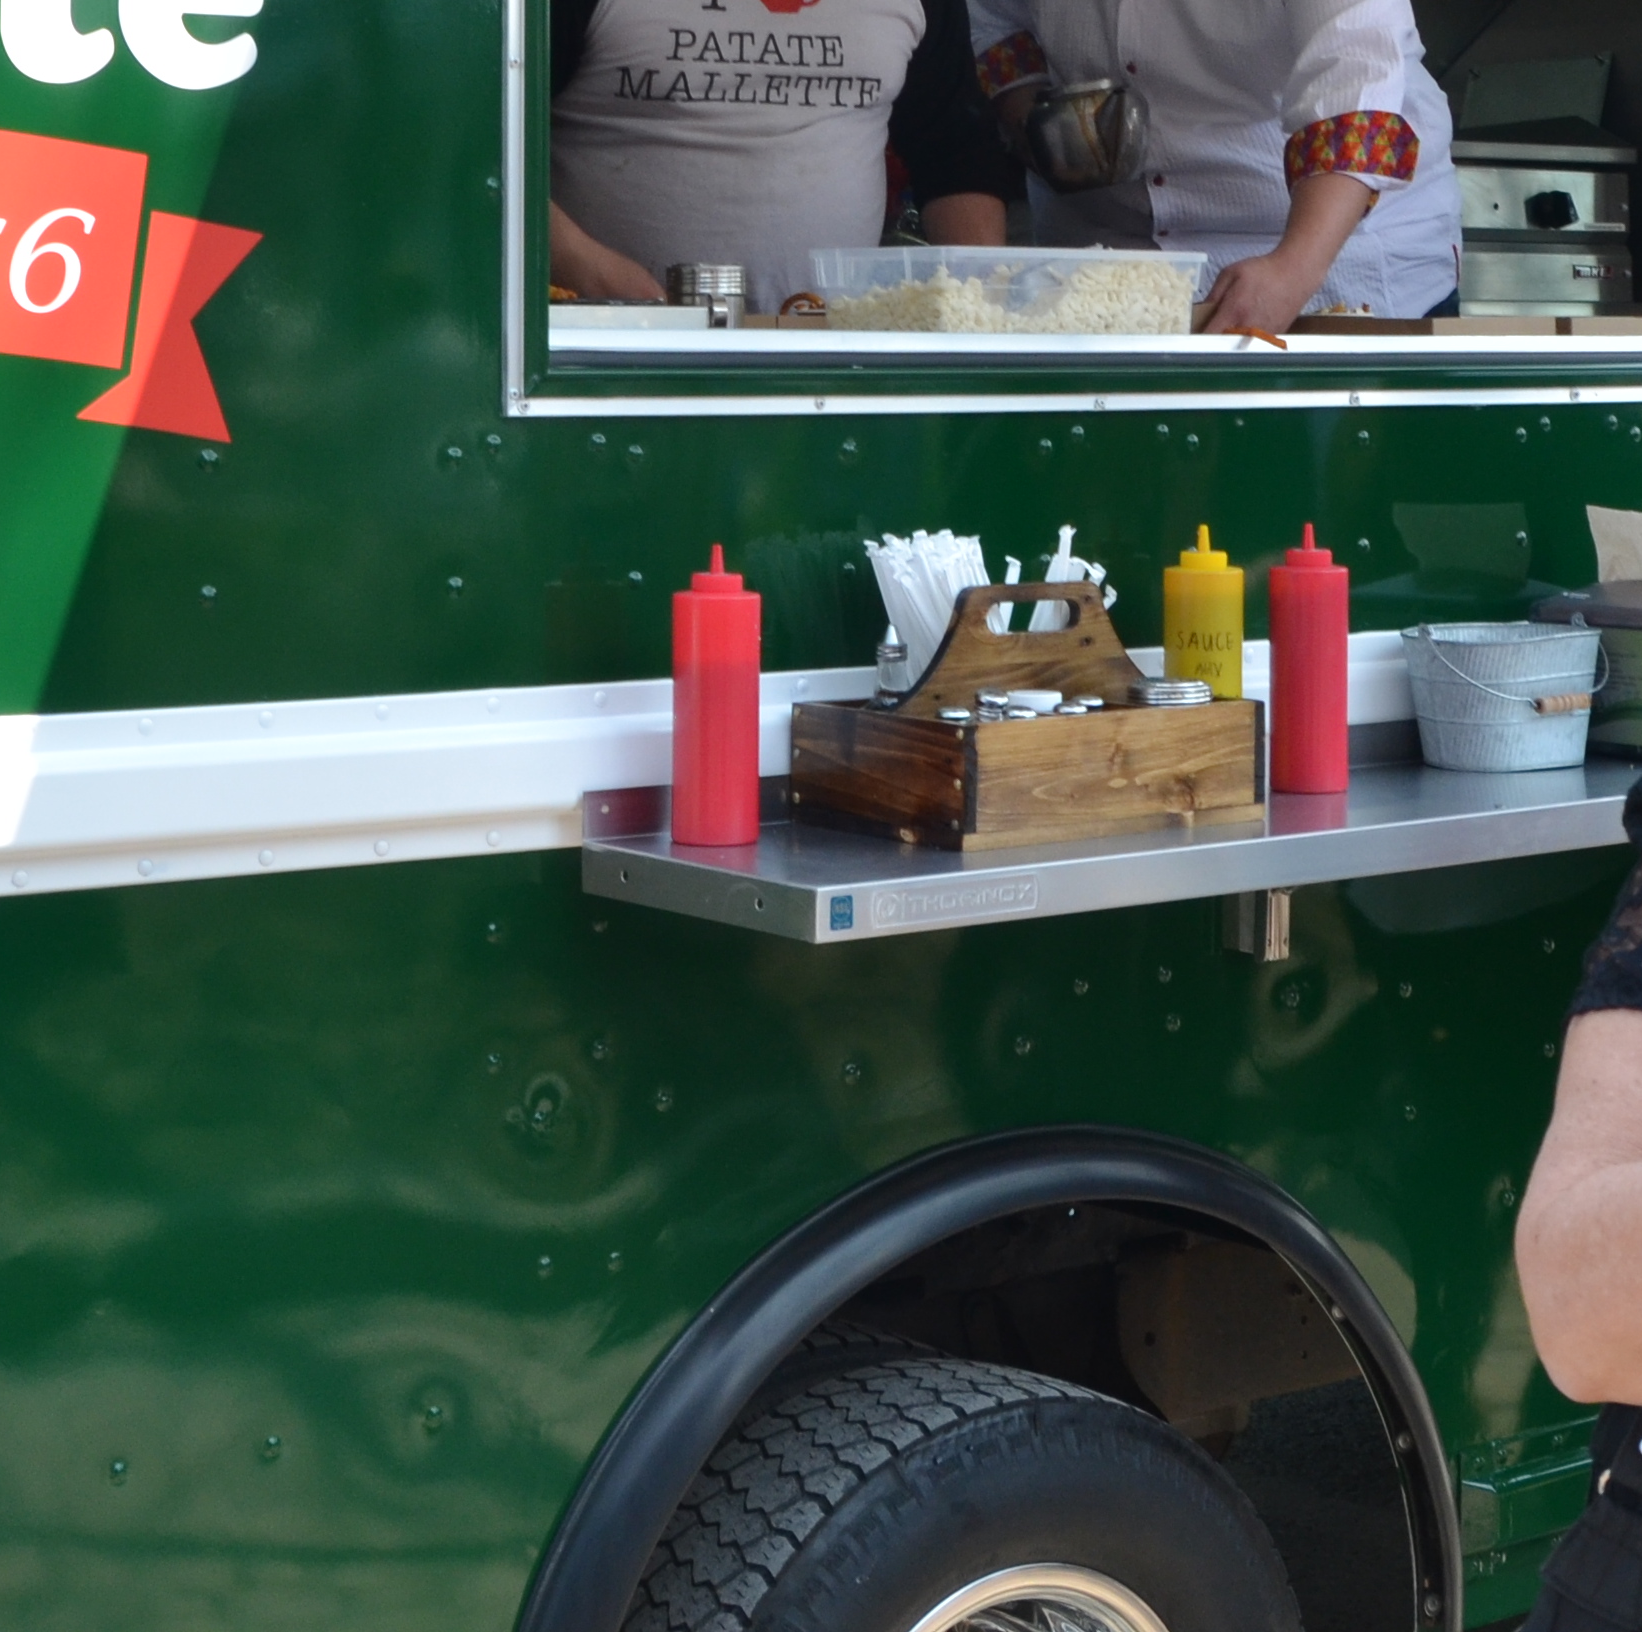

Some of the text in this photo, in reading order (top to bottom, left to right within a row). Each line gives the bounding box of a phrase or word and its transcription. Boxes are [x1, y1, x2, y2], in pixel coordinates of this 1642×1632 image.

[665, 28, 845, 67] PATATE
[614, 67, 882, 108] MALLETTE
[1176, 631, 1233, 652] SAUCE
